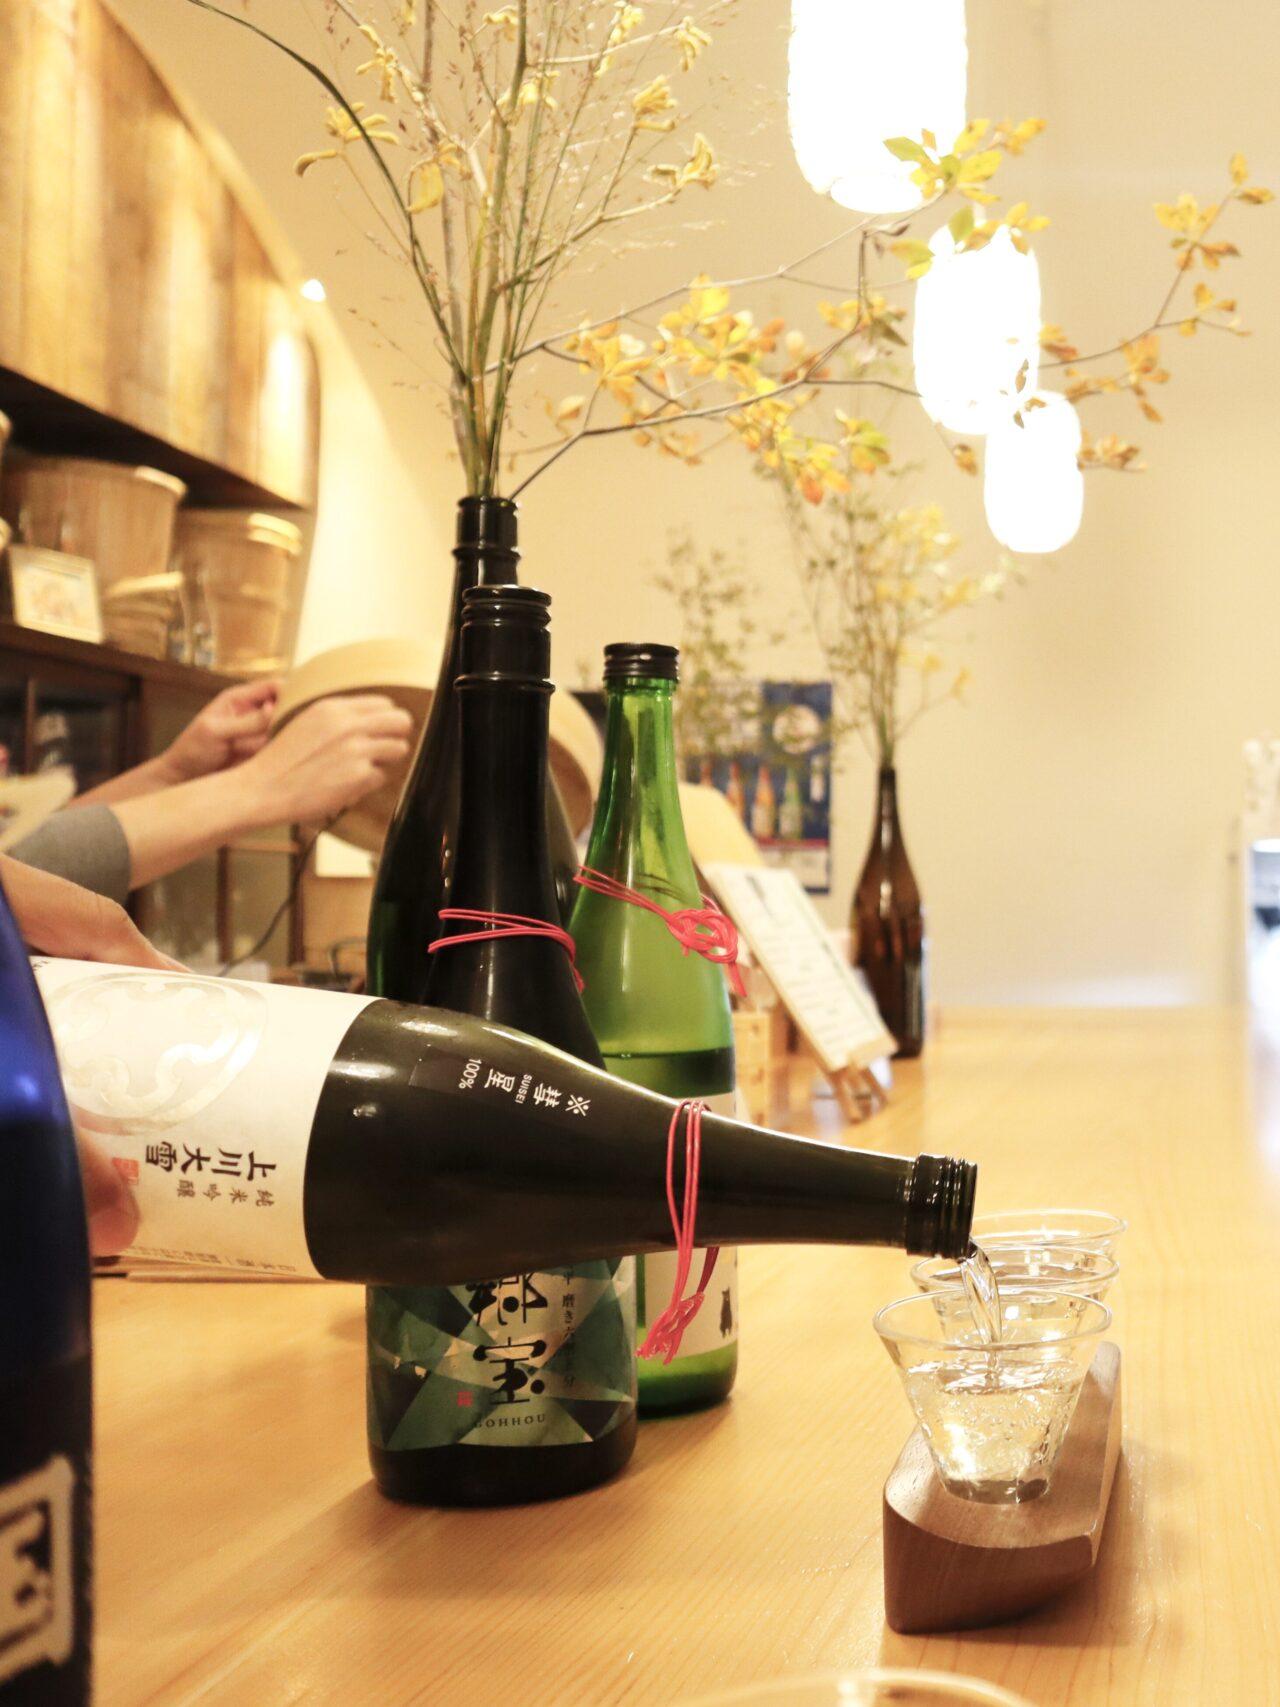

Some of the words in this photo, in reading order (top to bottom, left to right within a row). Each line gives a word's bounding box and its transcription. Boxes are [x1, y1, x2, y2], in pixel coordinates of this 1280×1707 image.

[458, 1058, 482, 1089] 100%
[515, 1074, 533, 1104] SUISEI
[145, 1141, 277, 1181] 上川大雪
[177, 1179, 275, 1207] 純米吟醸
